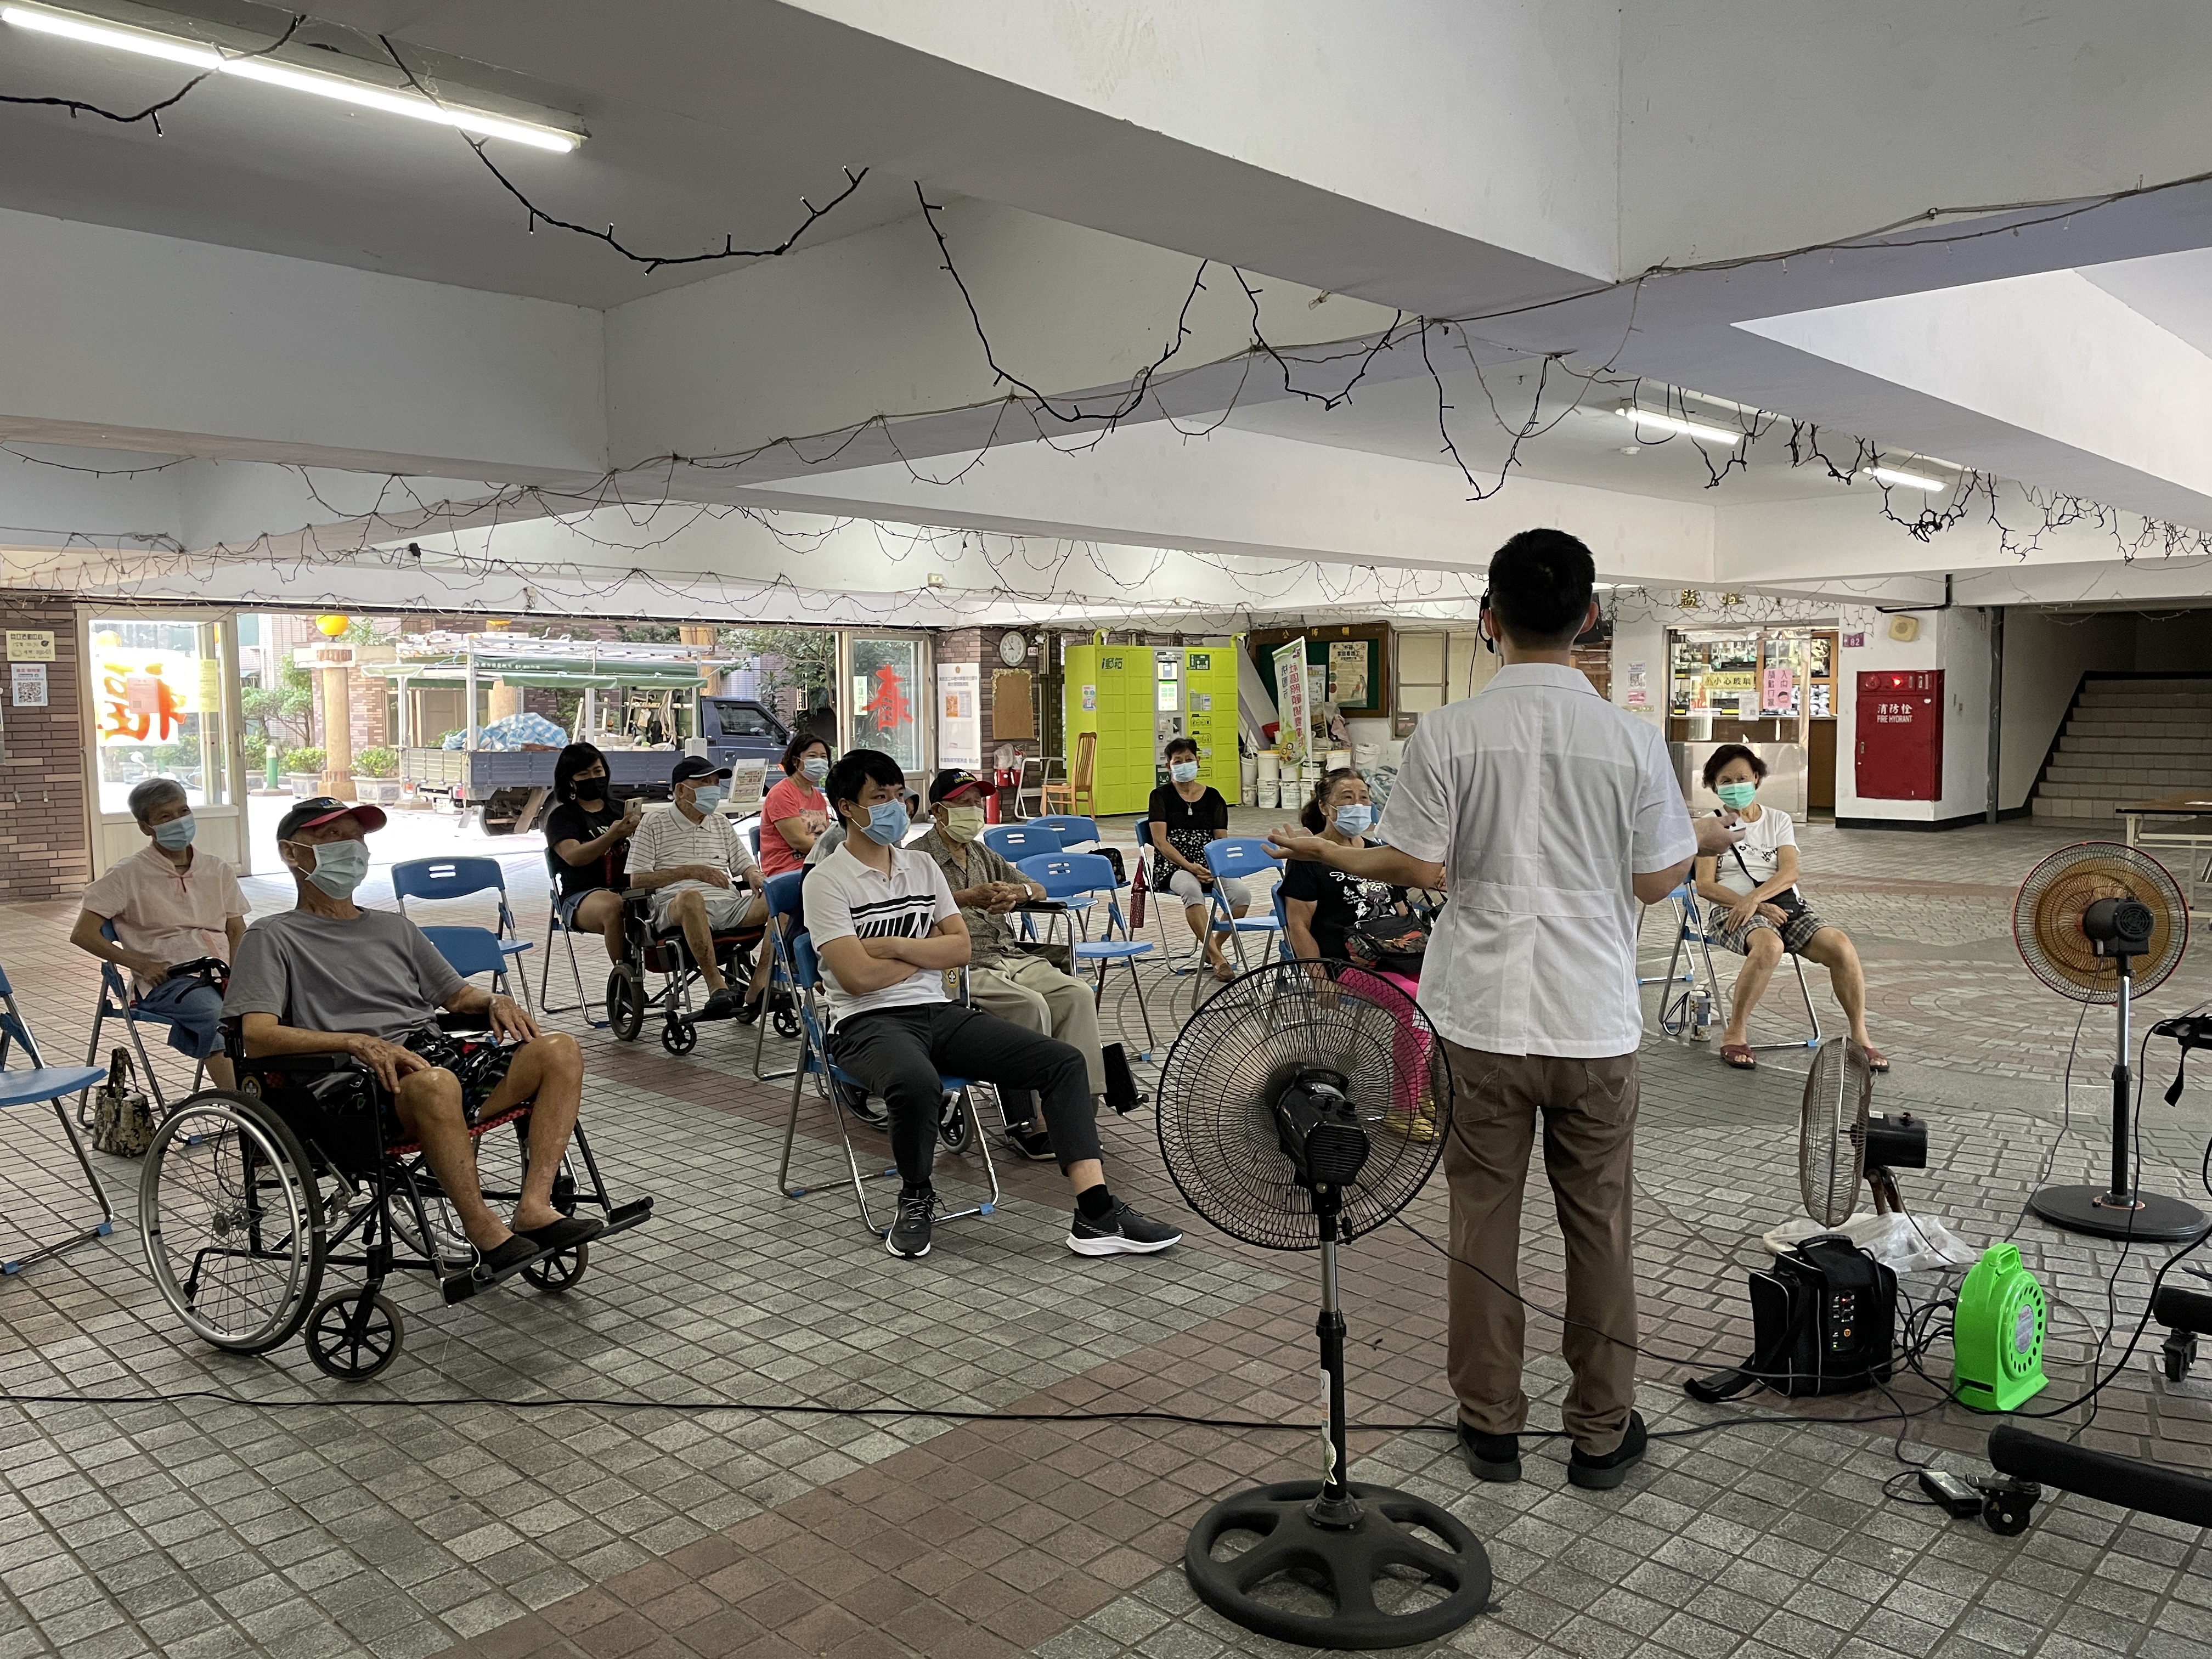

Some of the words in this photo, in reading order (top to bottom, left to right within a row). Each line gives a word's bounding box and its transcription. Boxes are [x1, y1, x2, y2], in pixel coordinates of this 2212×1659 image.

[1850, 638, 1860, 646] 82
[1714, 677, 1751, 685] 小心玻璃
[862, 664, 913, 731] 春
[1877, 703, 1913, 714] 消防栓
[1877, 715, 1888, 723] FIRE
[1889, 715, 1913, 723] HYDRANT
